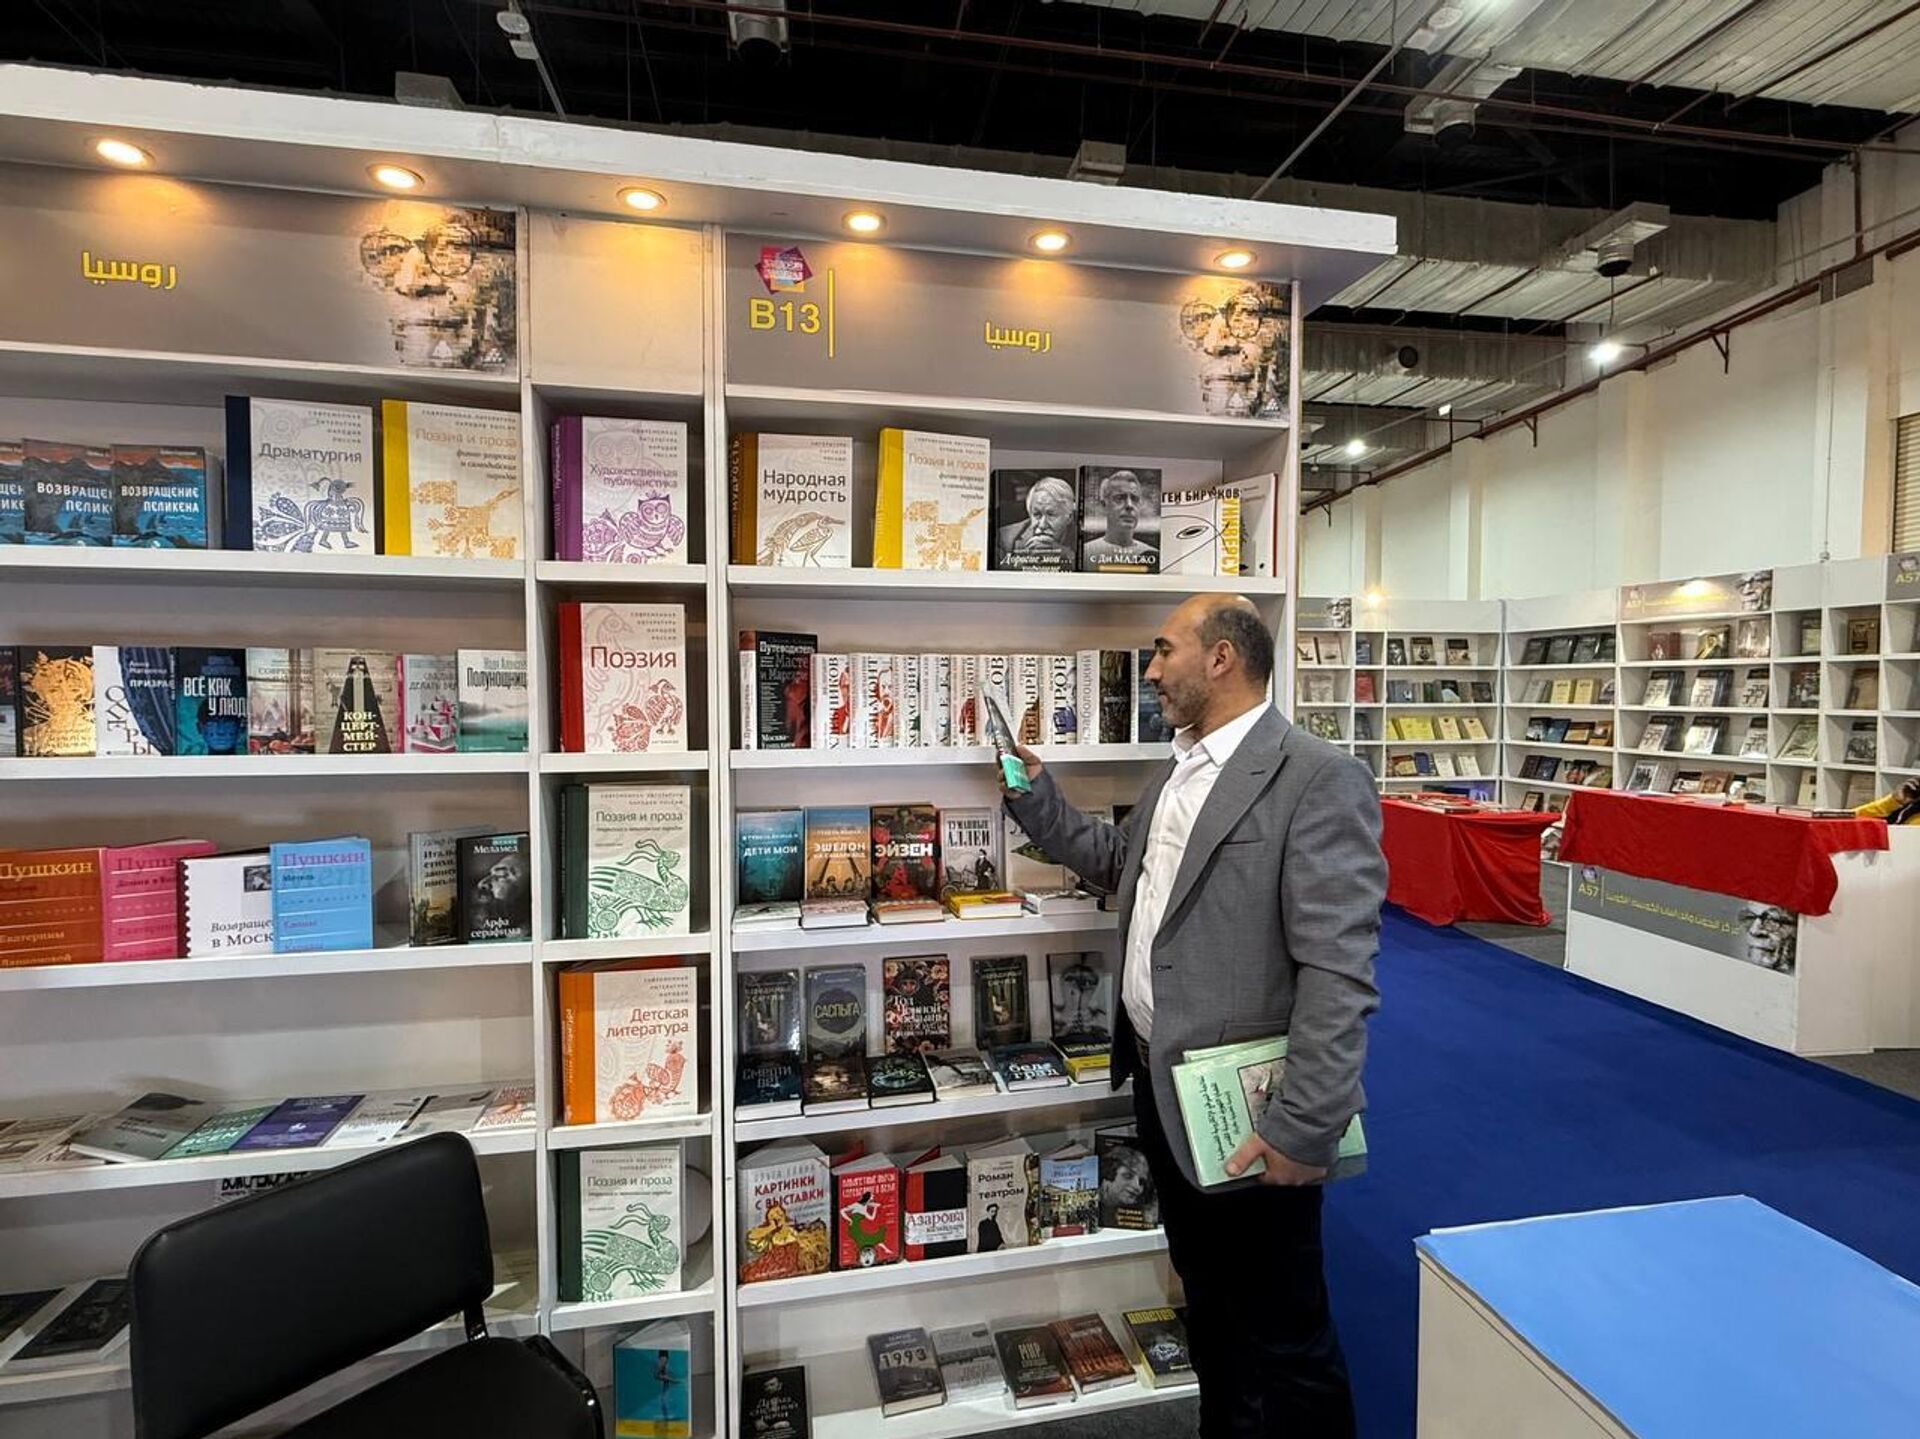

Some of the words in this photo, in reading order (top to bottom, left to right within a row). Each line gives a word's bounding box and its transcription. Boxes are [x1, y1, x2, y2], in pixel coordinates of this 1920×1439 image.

[81, 250, 178, 290] روسيا
[749, 297, 821, 334] B13
[983, 320, 1053, 354] روسيا
[415, 428, 463, 444] Поэзия
[258, 442, 363, 466] Драматургия
[762, 469, 847, 488] Народная
[36, 482, 113, 500] ВОЗВРАЩЕ
[120, 485, 200, 499] ВОЗВРАЩЕНИЕ
[762, 488, 847, 504] мудрость
[66, 500, 113, 516] ПЕЛИК
[143, 500, 200, 513] ПЕЛИКЕНА
[590, 645, 677, 669] Поэзия
[208, 678, 233, 698] КАК
[868, 656, 880, 750] БАЛЬМОНТ
[1054, 656, 1067, 745] ПЕТРОВ
[343, 710, 377, 722] КОН-
[341, 721, 381, 733] ЦЕРТ-
[342, 730, 379, 742] МЕЙ-
[342, 741, 378, 752] СТЕР
[596, 810, 637, 822] Поэзия
[639, 813, 648, 822] и
[649, 812, 684, 825] проза
[743, 846, 772, 858] ДЕТИ
[773, 845, 798, 855] МОИ
[813, 841, 866, 853] ЭШЕЛОН
[875, 840, 934, 858] ЭЙЗЕН
[281, 852, 365, 869] Пушкин
[0, 862, 94, 882] Пушкин
[483, 917, 510, 929] Арфа
[470, 927, 522, 939] серафима
[211, 937, 221, 948] в
[630, 1008, 689, 1024] Детская
[606, 1023, 689, 1039] литература
[587, 1175, 628, 1187] Поэзия
[640, 1176, 673, 1188] проза
[977, 1172, 1014, 1184] Роман
[754, 1176, 815, 1197] КАРТИНКИ
[978, 1186, 1025, 1200] театром
[755, 1199, 762, 1210] С
[765, 1187, 824, 1208] ВЫСТАВКИ
[906, 1210, 965, 1228] Азарова
[881, 1347, 928, 1369] 1993
